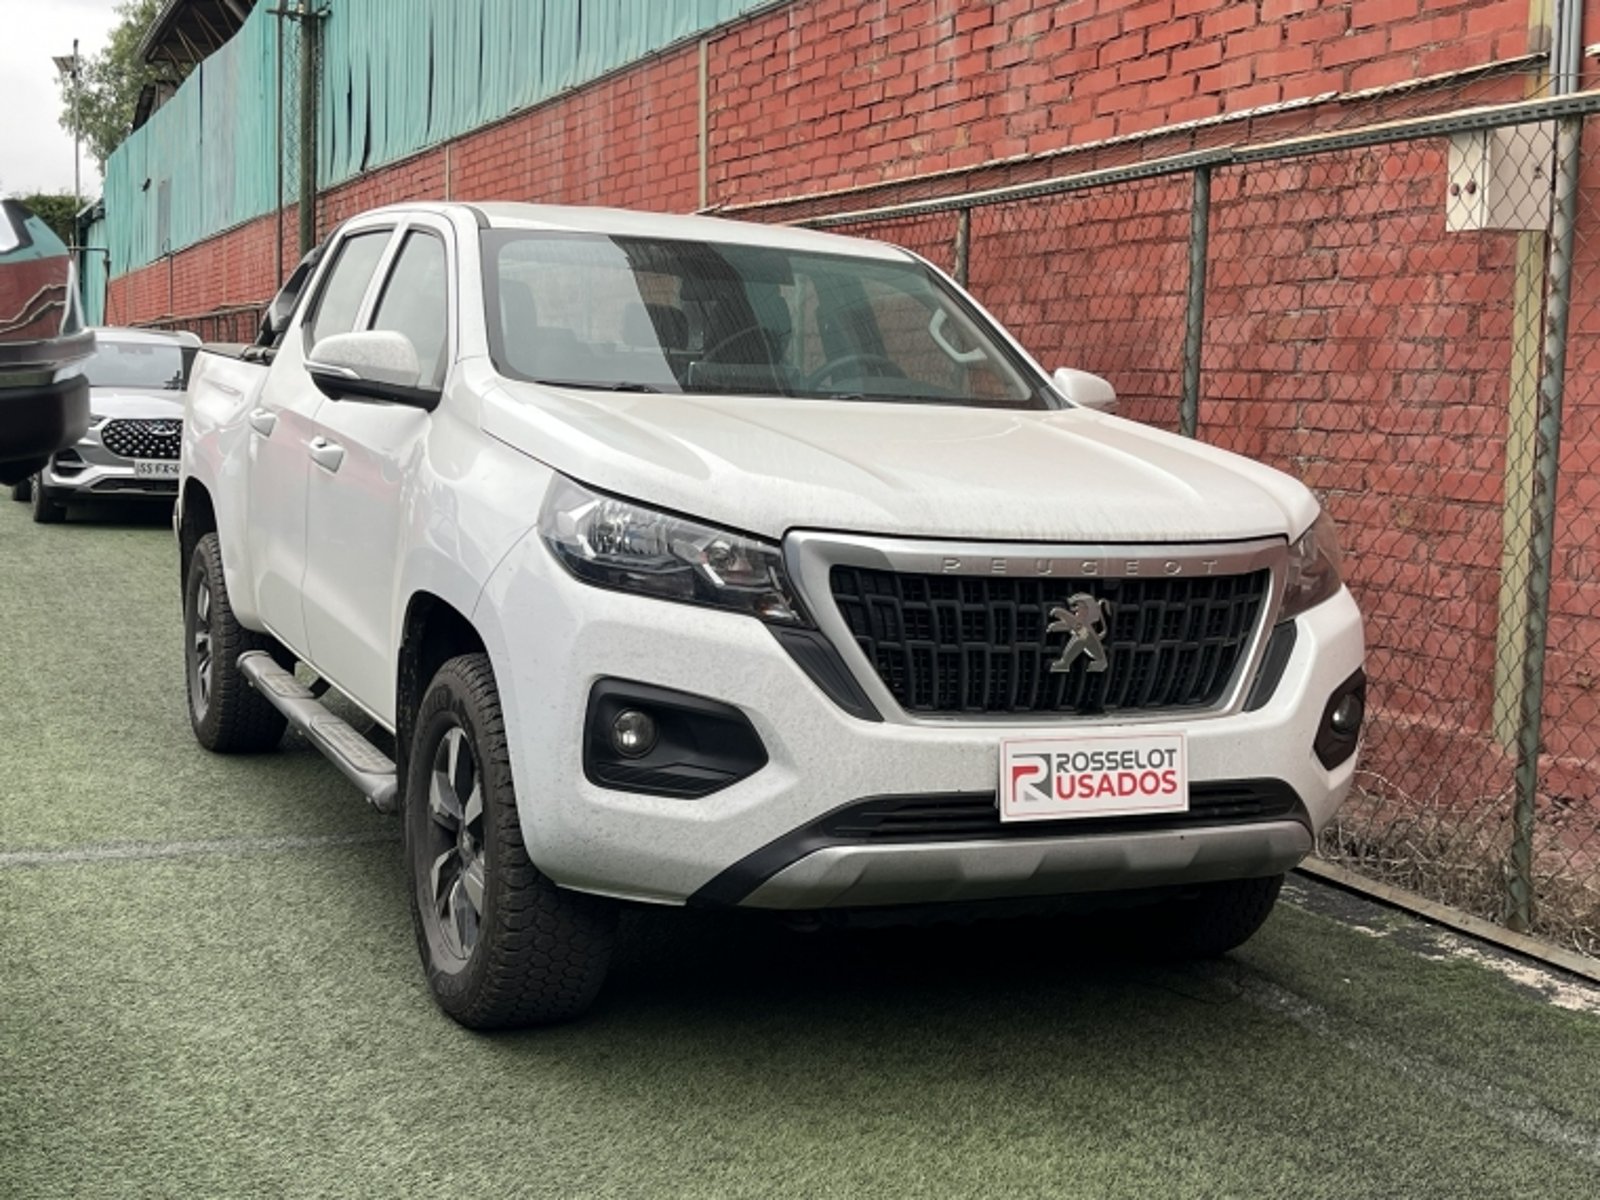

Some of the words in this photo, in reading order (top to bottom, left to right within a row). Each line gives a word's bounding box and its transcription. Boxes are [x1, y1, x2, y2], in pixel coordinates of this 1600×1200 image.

[942, 557, 1218, 576] PEUGEOT
[1056, 748, 1177, 773] ROSSELOT
[1056, 770, 1178, 799] USADOS
